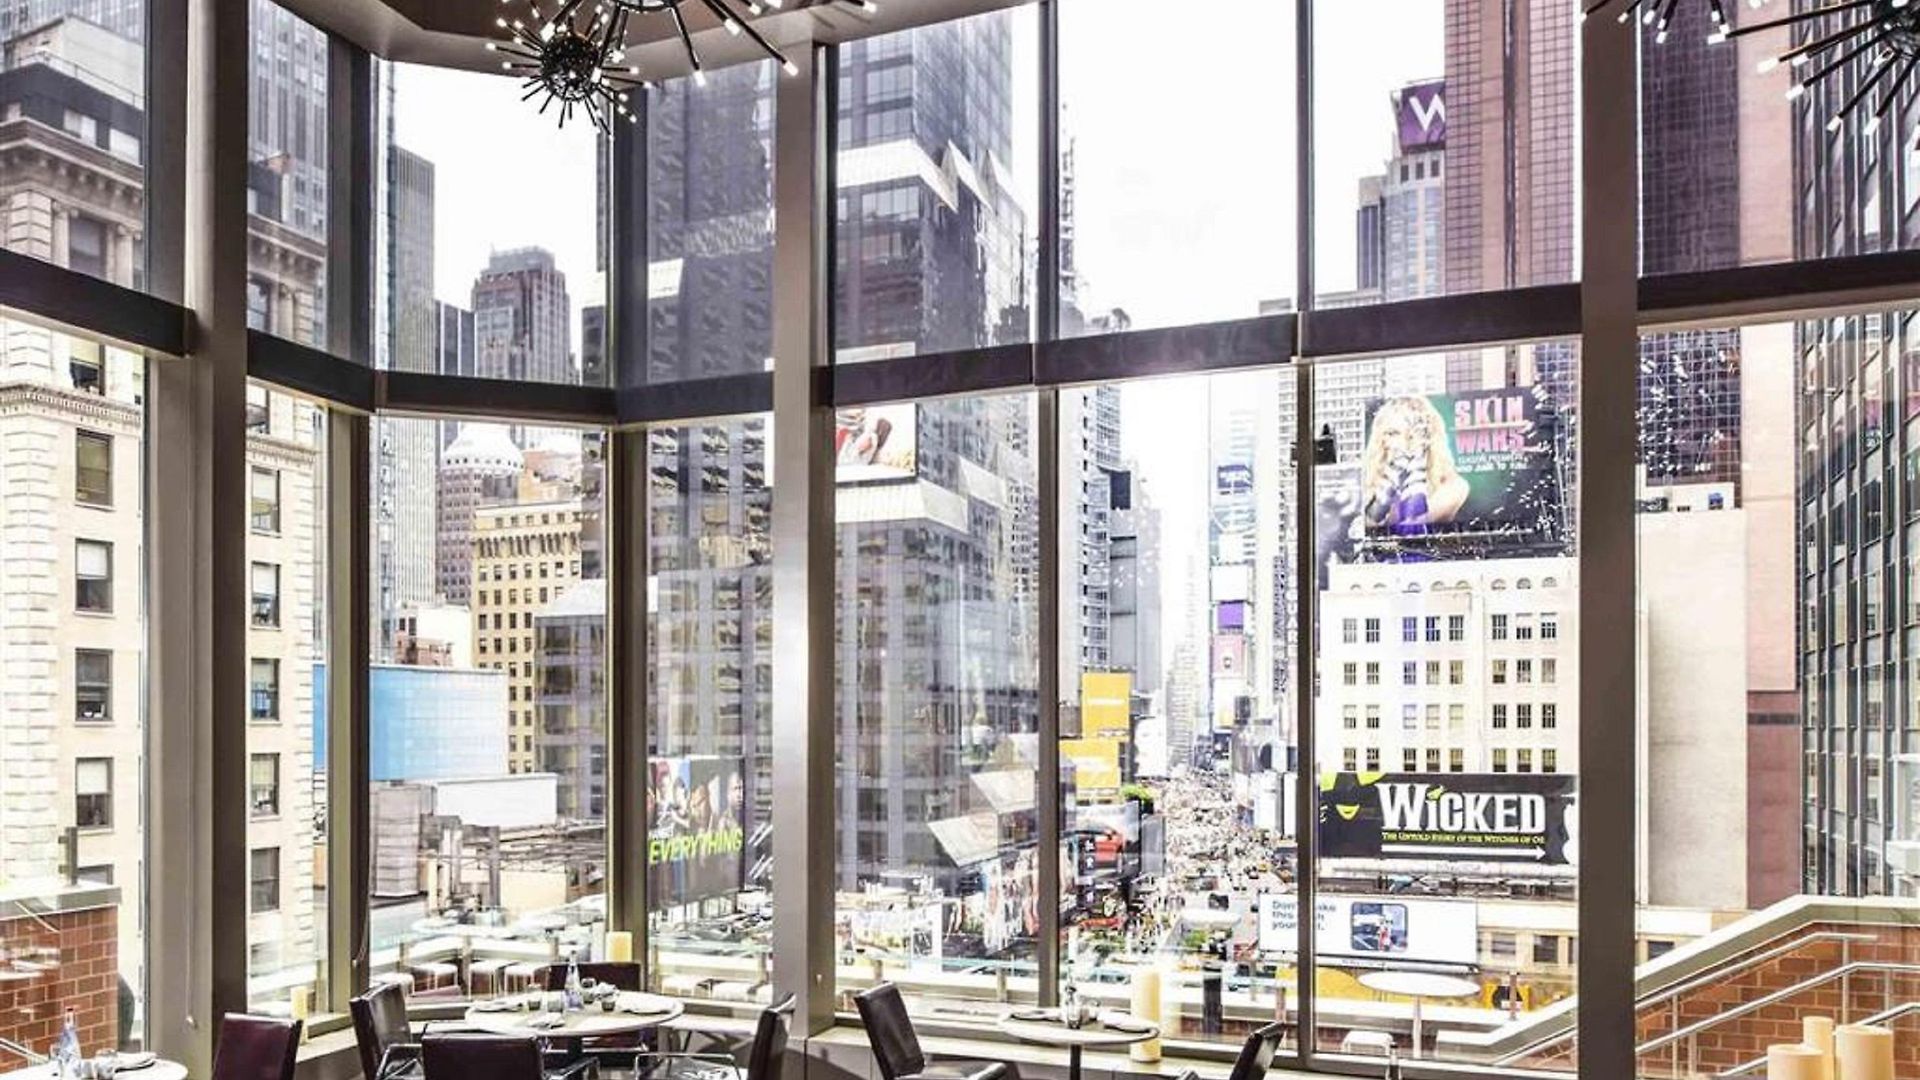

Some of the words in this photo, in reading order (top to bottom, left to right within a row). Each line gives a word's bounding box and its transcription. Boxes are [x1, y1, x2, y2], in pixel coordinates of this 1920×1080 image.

[1409, 93, 1445, 131] W
[1455, 396, 1523, 429] SKIN
[1456, 429, 1525, 454] WARS
[649, 826, 743, 865] EVERYTHING
